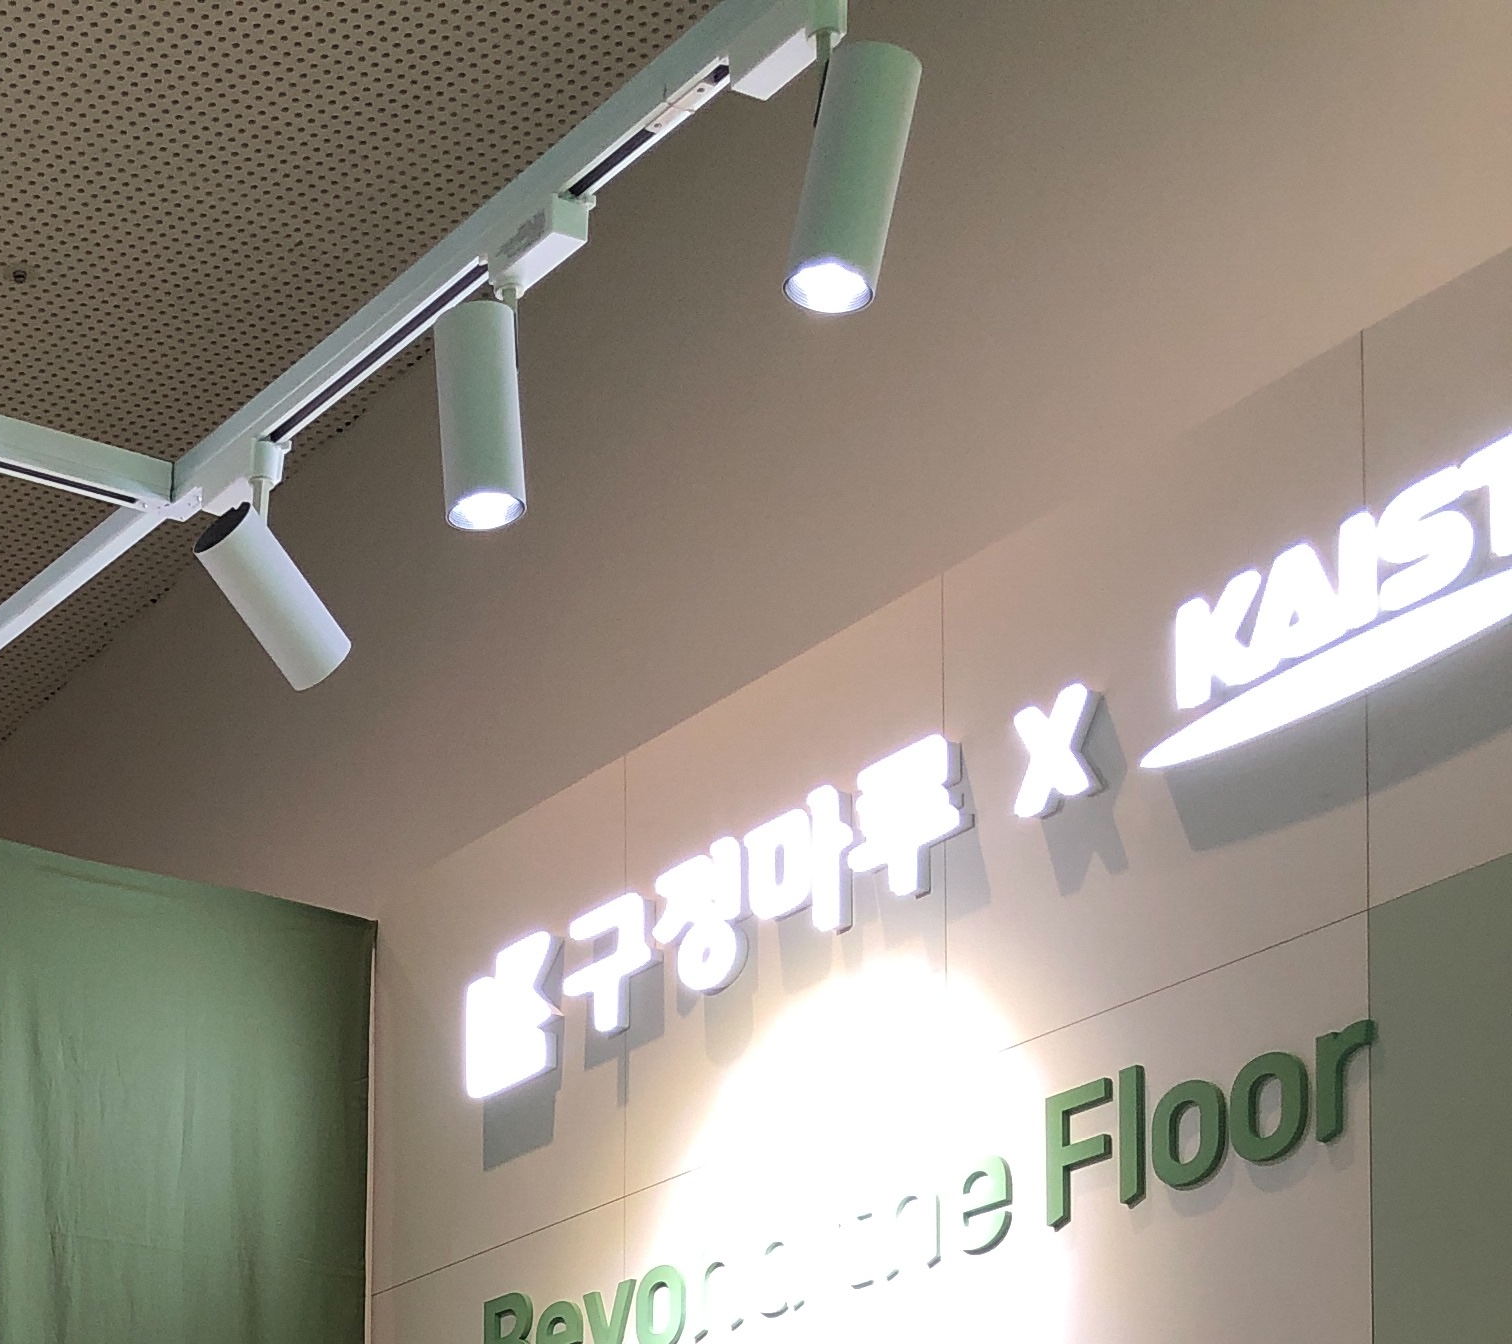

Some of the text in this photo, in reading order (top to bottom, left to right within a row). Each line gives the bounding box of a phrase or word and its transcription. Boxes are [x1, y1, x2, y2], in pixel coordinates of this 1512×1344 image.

[562, 733, 975, 1037] 구정마루
[1174, 432, 1512, 710] KAIST
[1045, 1018, 1377, 1231] Floor
